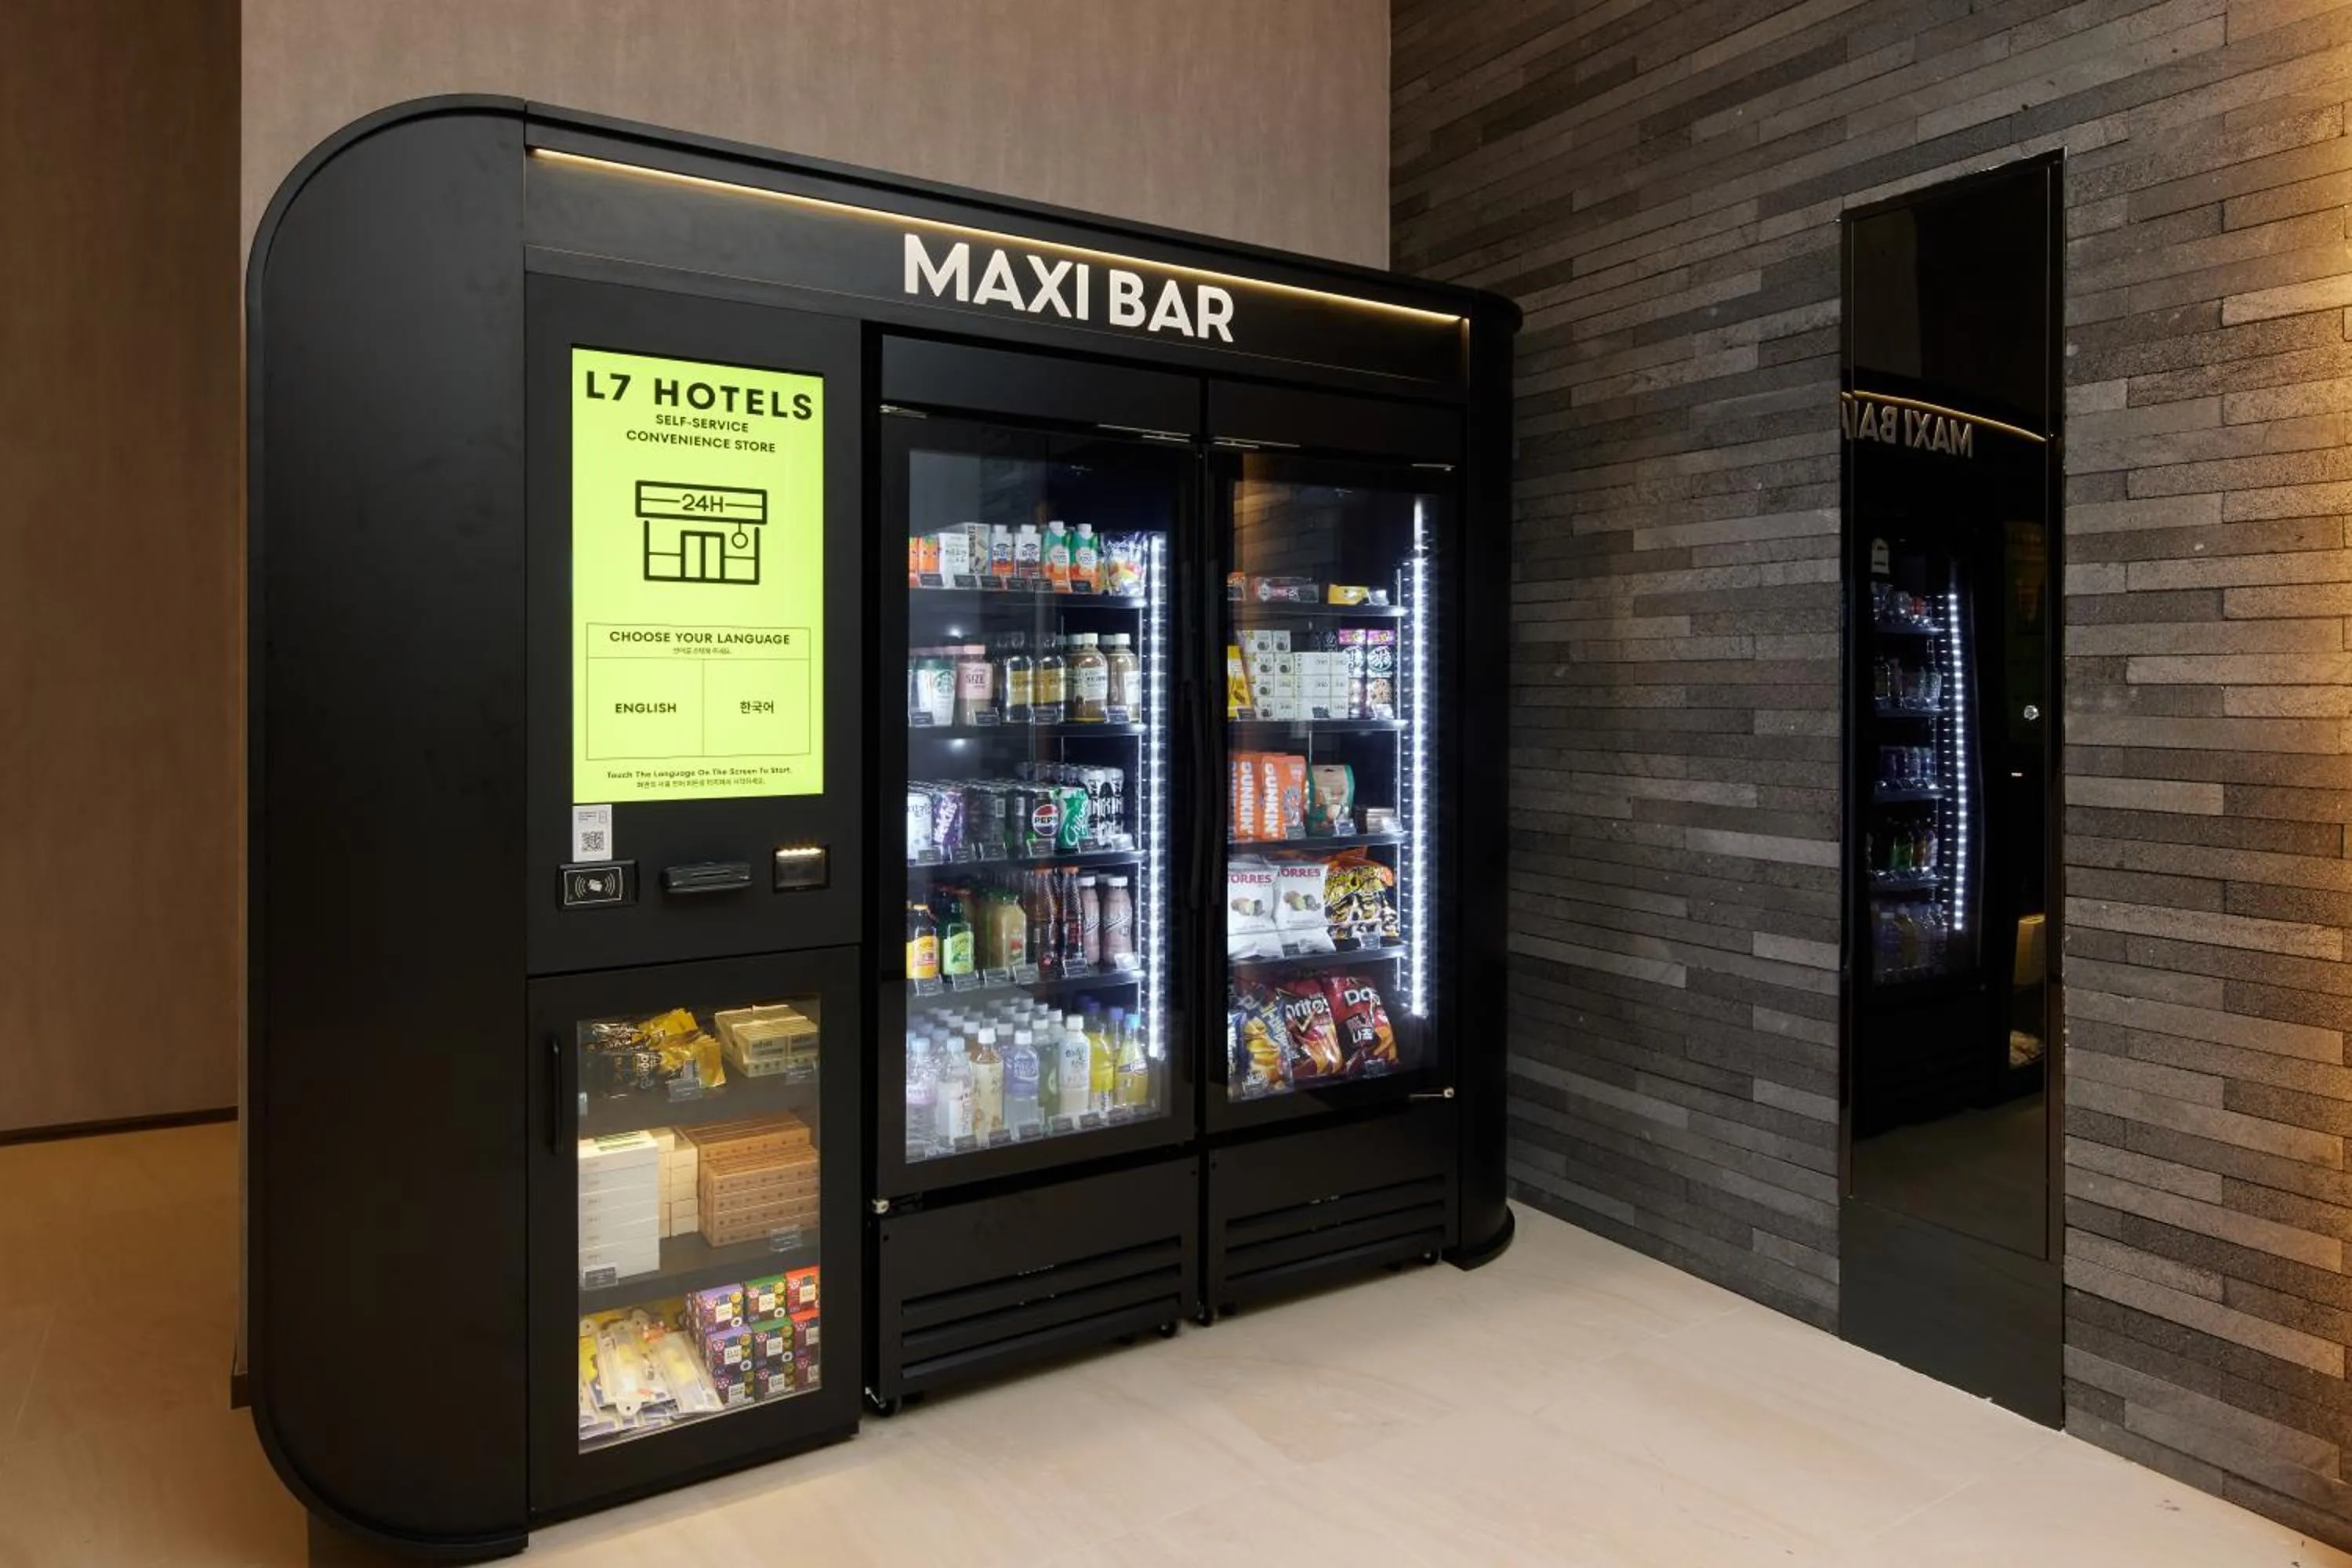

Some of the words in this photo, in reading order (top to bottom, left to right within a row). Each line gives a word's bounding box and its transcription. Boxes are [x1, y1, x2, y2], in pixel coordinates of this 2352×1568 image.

[904, 233, 1089, 321] MAXI
[1109, 269, 1234, 343] BAR
[586, 371, 632, 401] L7
[654, 377, 813, 420] HOTELS
[655, 414, 750, 433] SELF-SERVICE
[626, 430, 731, 449] CONVENIENCE
[735, 440, 776, 453] STORE
[681, 493, 724, 513] 24H
[609, 630, 670, 643] CHOOSE
[675, 632, 713, 644] YOUR
[717, 633, 790, 645] LANGUAGE
[615, 702, 677, 713] ENGLISH
[740, 699, 775, 714] 한국어
[1229, 873, 1273, 884] ORRES
